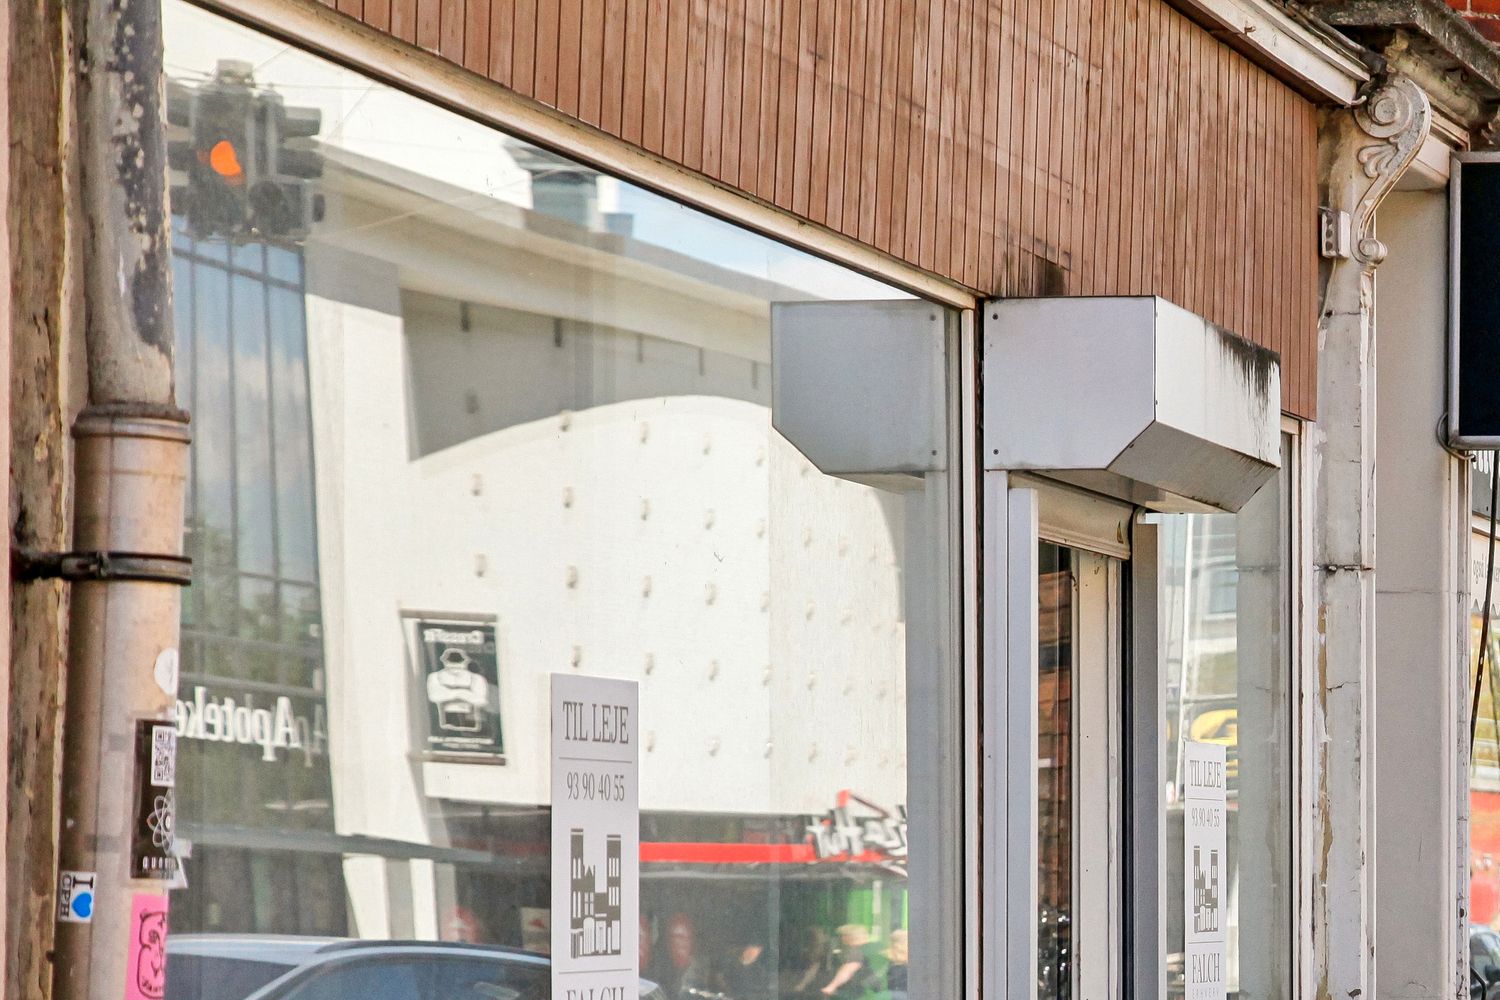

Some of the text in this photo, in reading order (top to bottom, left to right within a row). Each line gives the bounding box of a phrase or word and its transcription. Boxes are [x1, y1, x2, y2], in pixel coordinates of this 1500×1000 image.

[563, 701, 629, 745] TIL LEJE
[567, 771, 625, 802] 93 90 40 55
[1190, 760, 1221, 788] TIL LEJE
[61, 874, 71, 917] CPH
[1192, 953, 1220, 983] FALCH
